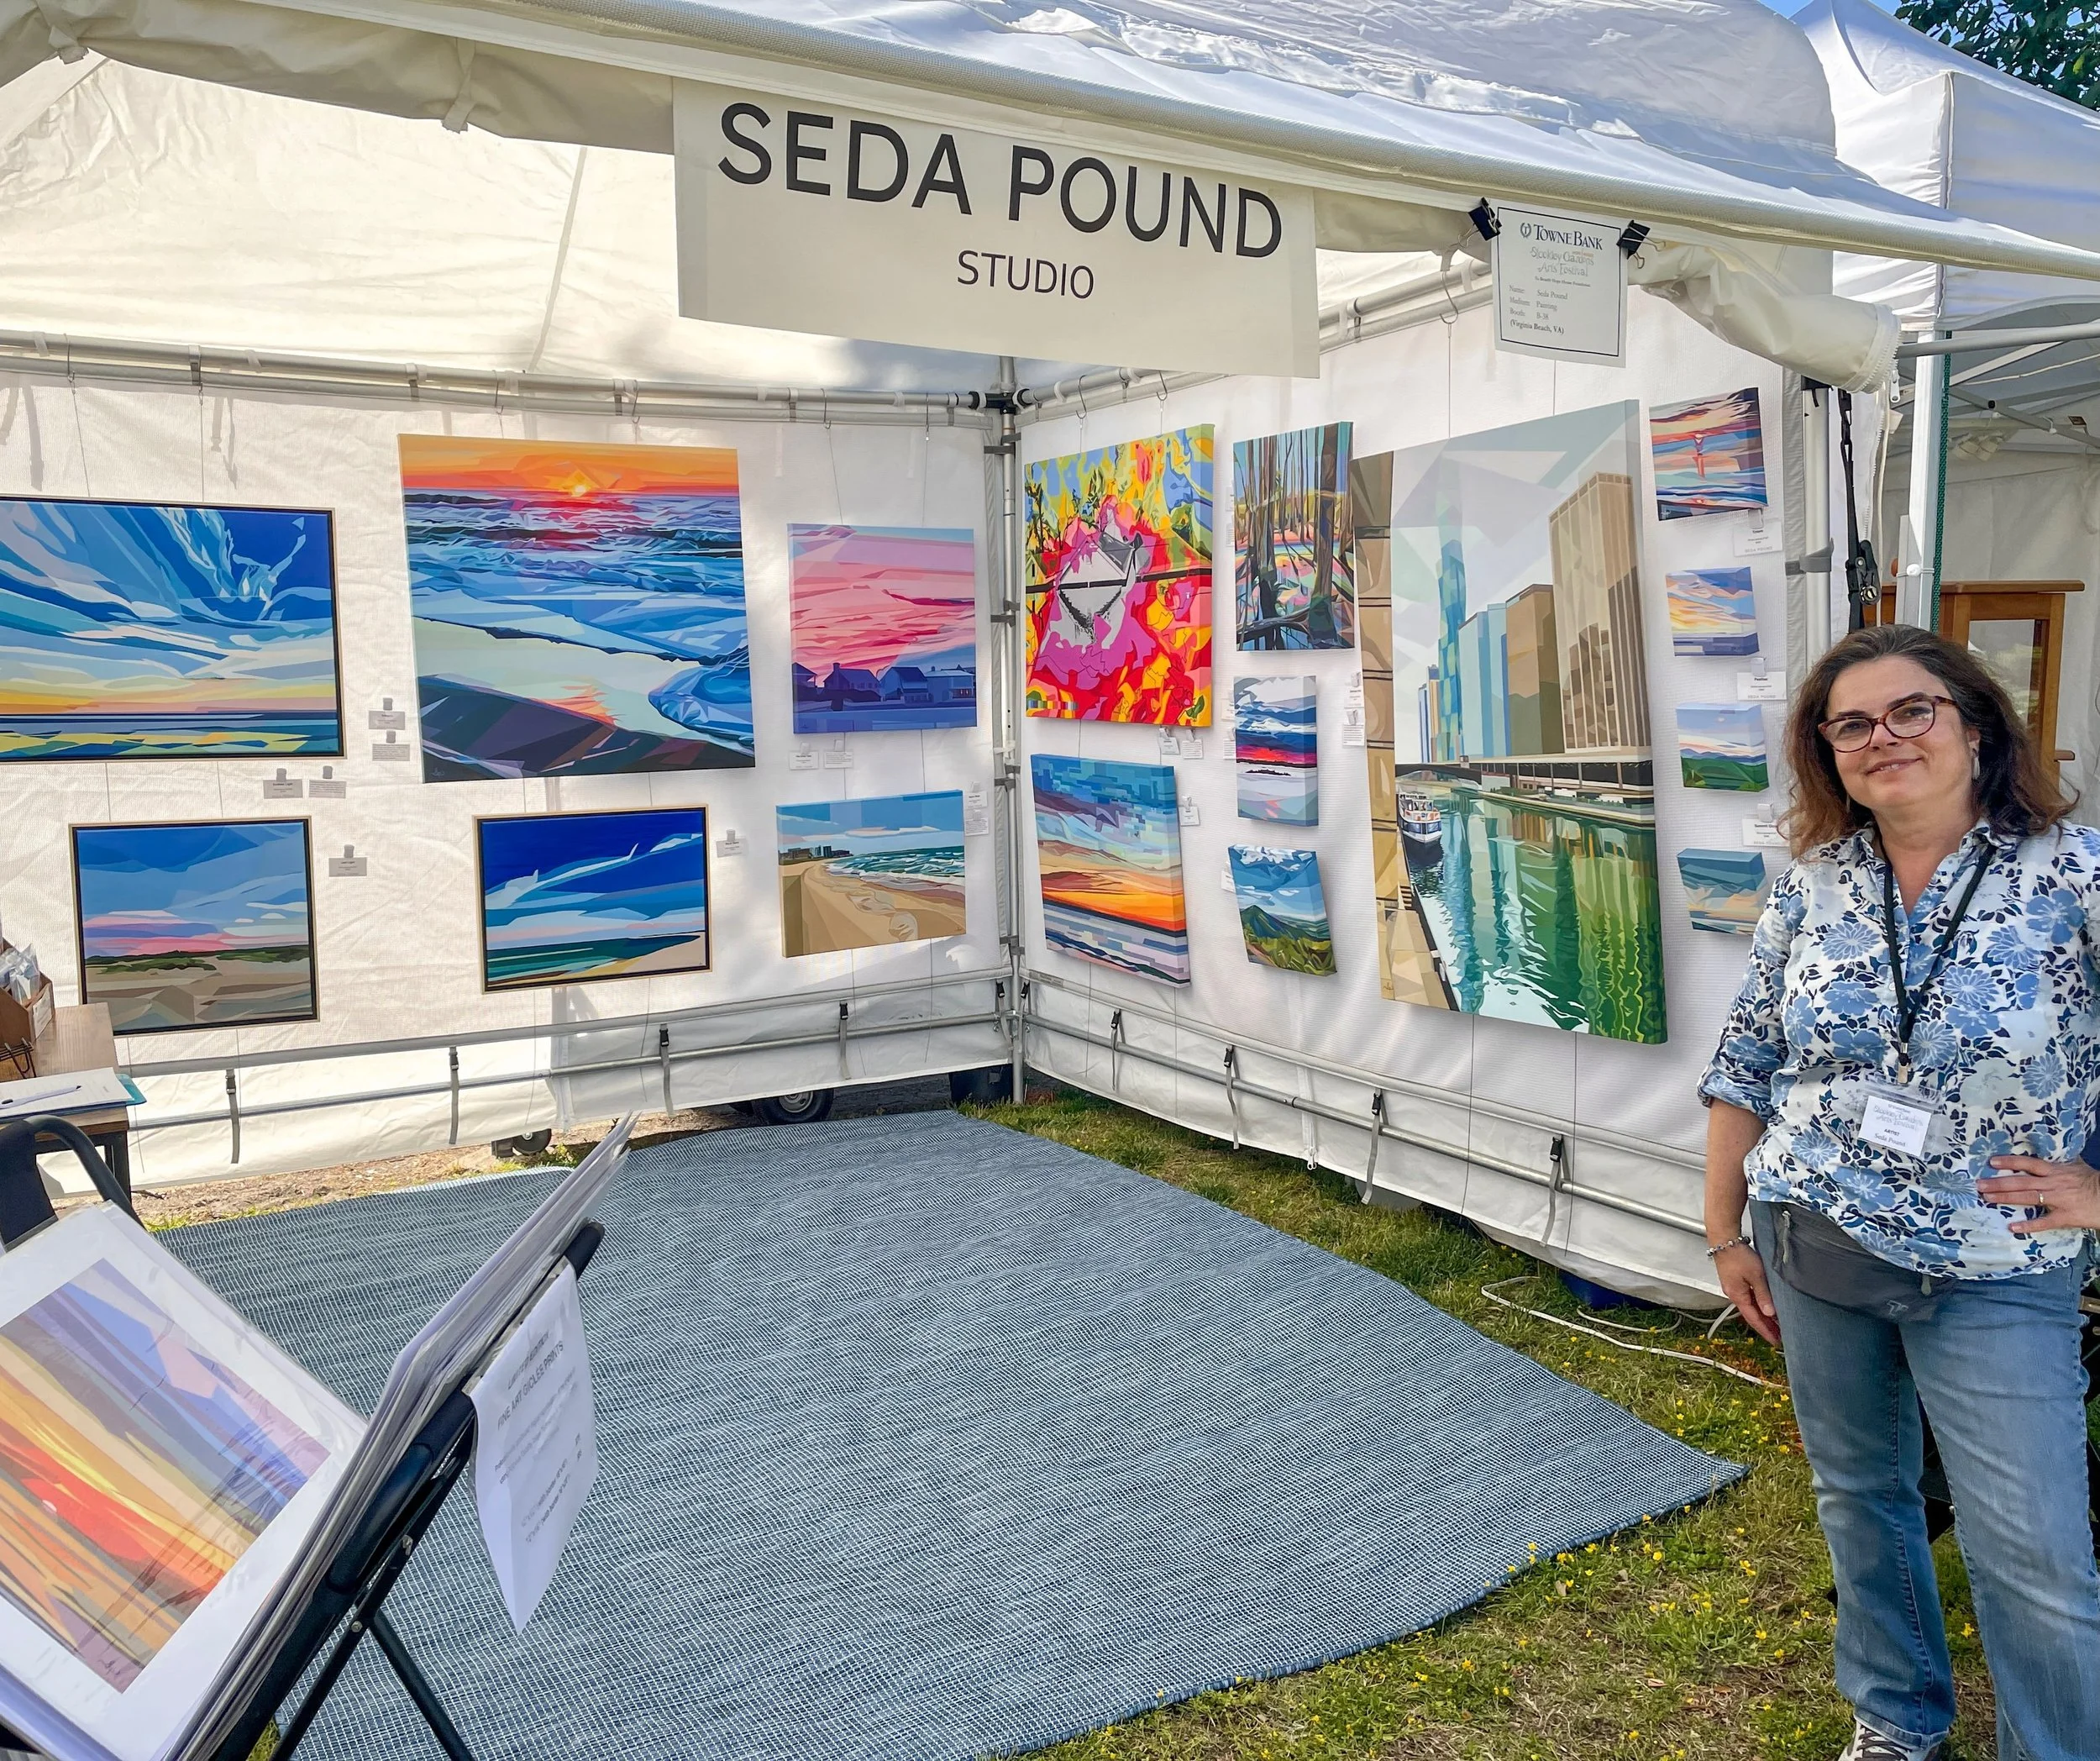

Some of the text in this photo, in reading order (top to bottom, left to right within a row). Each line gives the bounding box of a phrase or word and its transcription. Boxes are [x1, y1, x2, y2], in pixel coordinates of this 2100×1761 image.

[718, 102, 1284, 259] SEDA POUND
[957, 249, 1095, 300] STUDIO
[1538, 262, 1588, 277] Arts Festival
[1537, 289, 1549, 297] Seda
[1536, 301, 1557, 311] Painting
[1510, 319, 1564, 334] (Virginia Beach, VA)
[1888, 1137, 1905, 1146] Pound
[497, 1404, 512, 1431] FINE
[511, 1389, 523, 1412] ART
[543, 1339, 564, 1371] PRINTS
